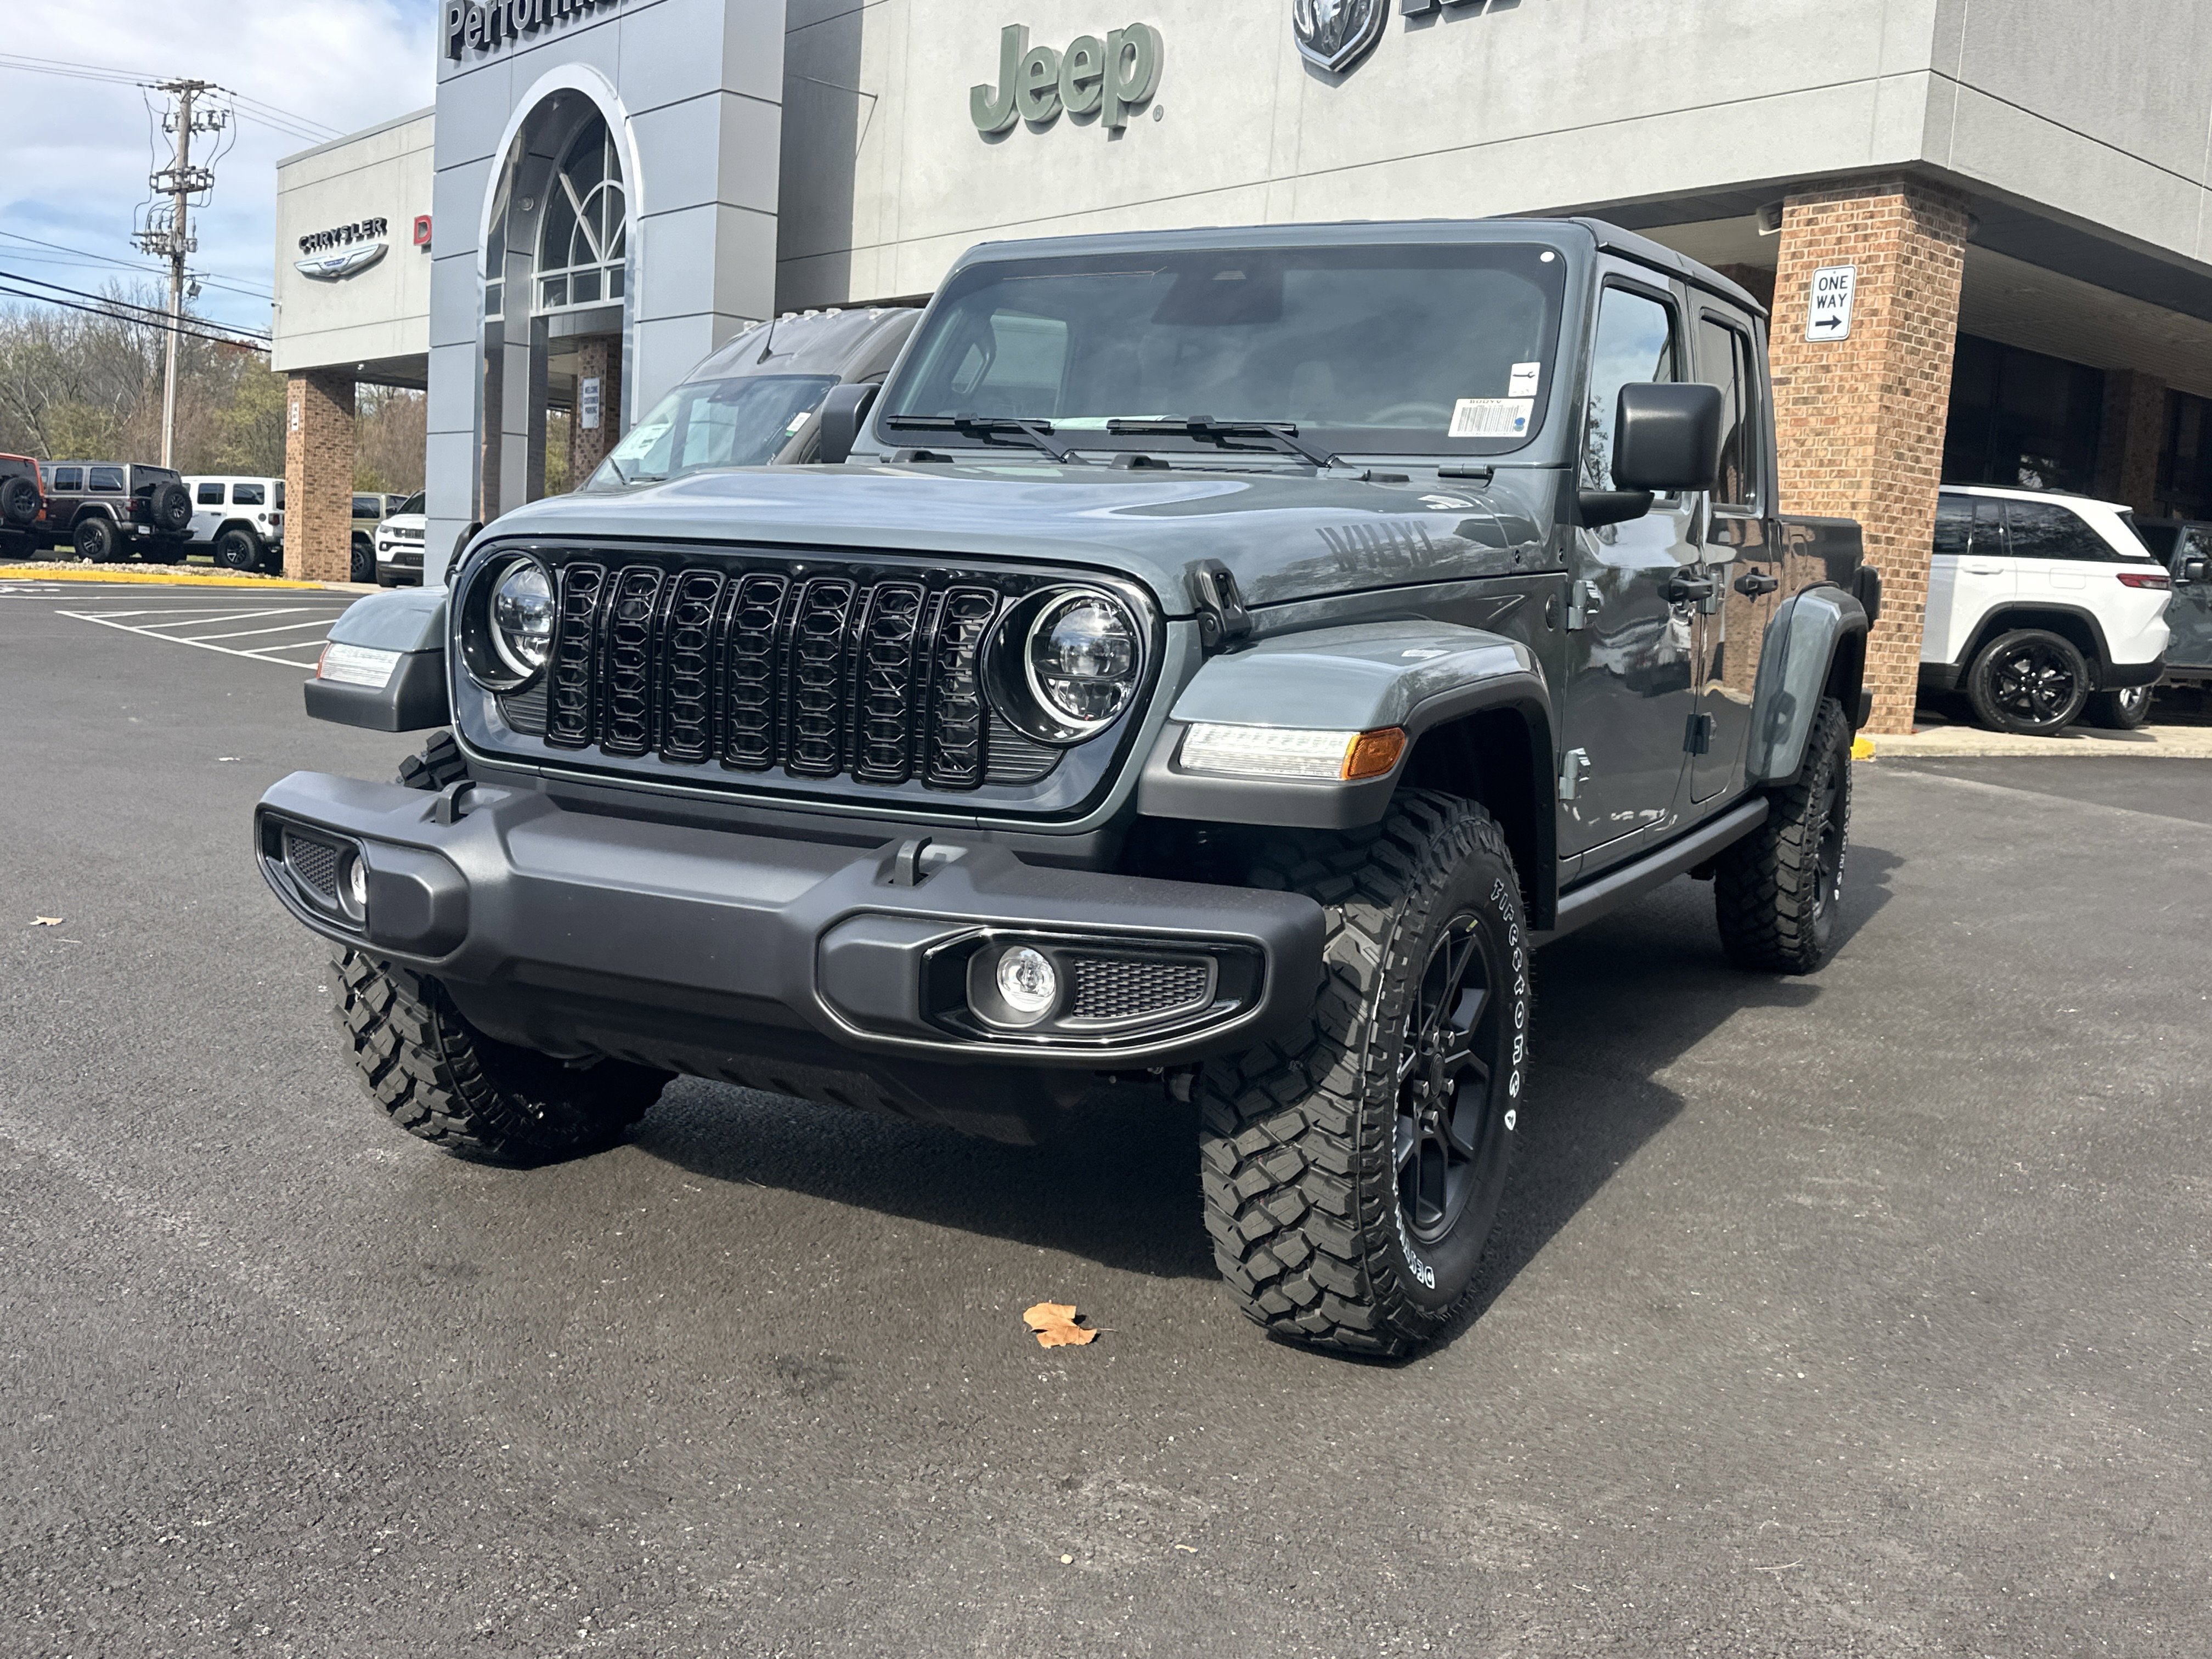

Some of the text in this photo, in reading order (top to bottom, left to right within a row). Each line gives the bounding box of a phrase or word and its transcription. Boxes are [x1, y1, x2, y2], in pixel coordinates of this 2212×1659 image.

[970, 22, 1163, 132] Jeep
[298, 217, 387, 251] CHRYSLER
[1819, 275, 1848, 291] ONE
[1817, 293, 1847, 309] WAY
[1491, 878, 1525, 1098] Firestone
